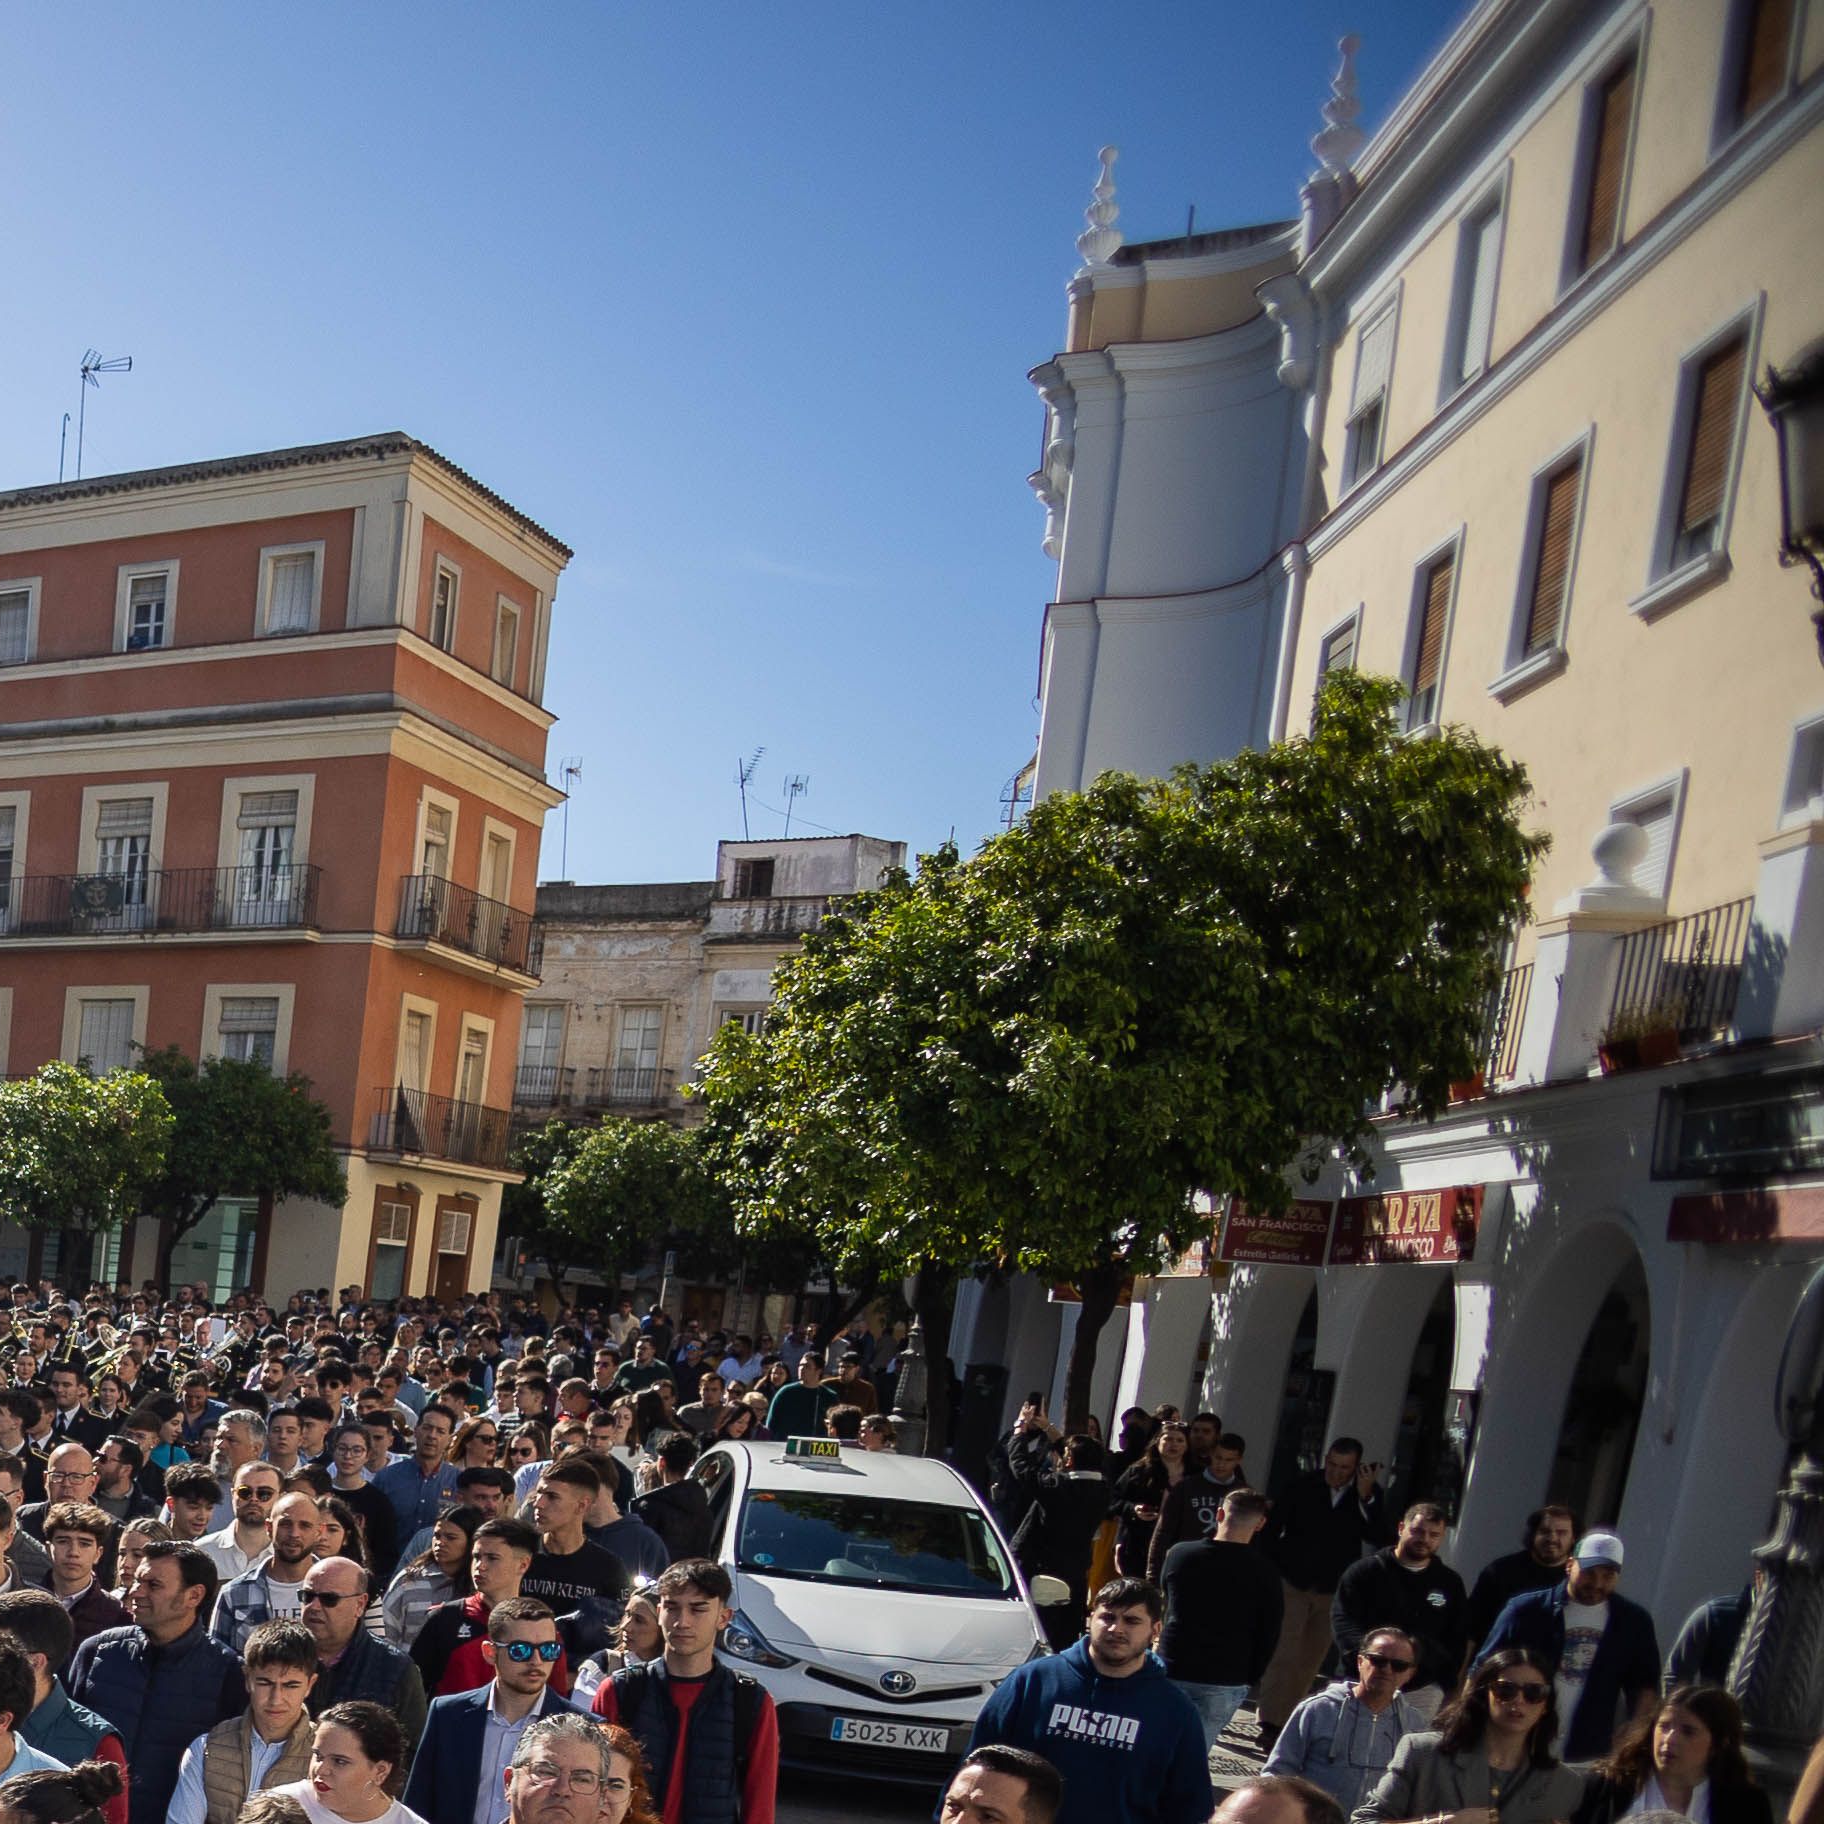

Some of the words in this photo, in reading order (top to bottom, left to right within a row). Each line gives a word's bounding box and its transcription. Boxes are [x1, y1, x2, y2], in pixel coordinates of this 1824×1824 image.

[1231, 1217, 1256, 1229] SAN
[1258, 1218, 1329, 1233] FRANCISCO
[1403, 1193, 1442, 1235] EVA
[811, 1441, 838, 1457] TAXI
[846, 1722, 897, 1744] 5025
[903, 1727, 944, 1748] KXK
[1047, 1703, 1141, 1744] PUMA
[1045, 1727, 1134, 1752] SPORTSWEAR
